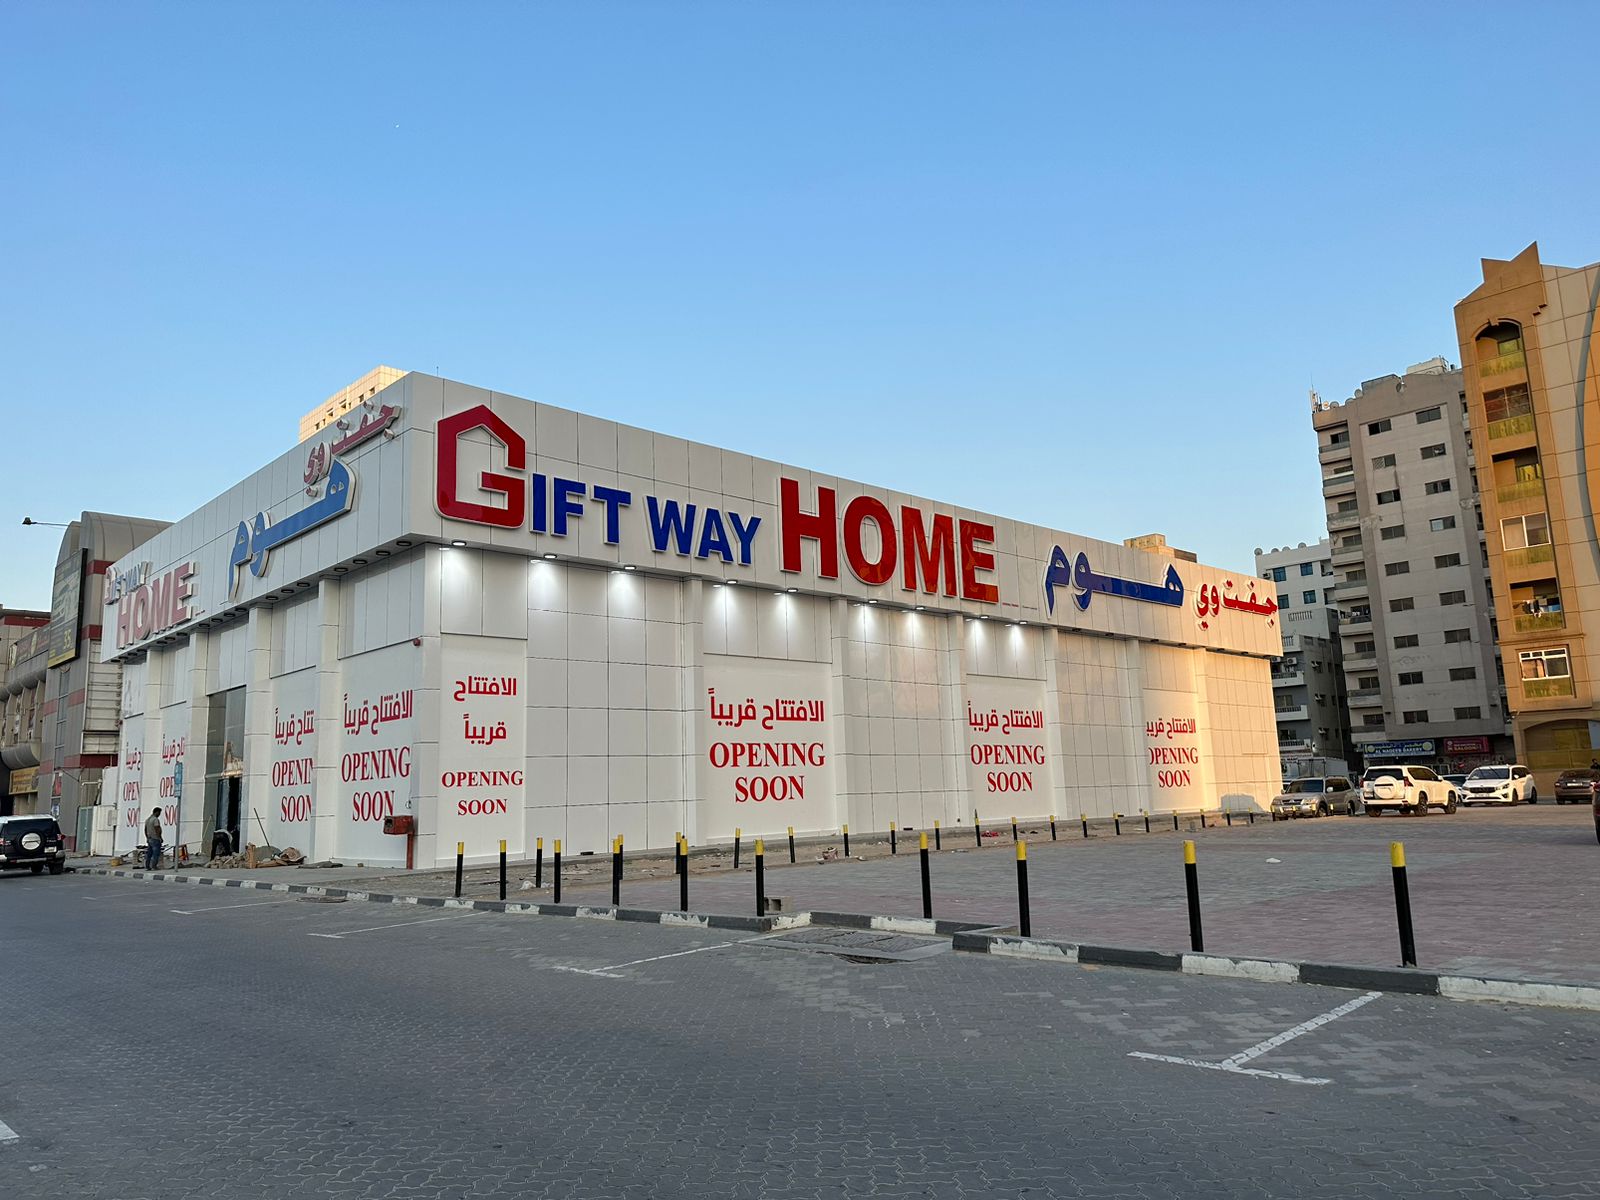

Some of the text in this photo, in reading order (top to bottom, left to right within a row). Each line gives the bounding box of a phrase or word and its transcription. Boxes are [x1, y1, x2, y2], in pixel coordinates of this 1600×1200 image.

[436, 404, 999, 603] GIFT WAY HOME
[1044, 544, 1184, 617] هوم
[117, 562, 196, 649] HOME
[454, 675, 517, 702] الافتتاح
[371, 690, 413, 735] الافتتاح
[761, 698, 825, 730] الافتتاح
[1002, 709, 1043, 735] الافتتاح
[341, 746, 412, 782] OPENING
[709, 742, 825, 769] OPENING
[970, 744, 1045, 766] OPENING
[441, 770, 523, 789] OPENING
[735, 775, 805, 803] SOON
[987, 771, 1033, 793] SOON
[1157, 770, 1191, 788] SOON
[353, 790, 396, 822] SOON
[457, 798, 508, 816] SOON
